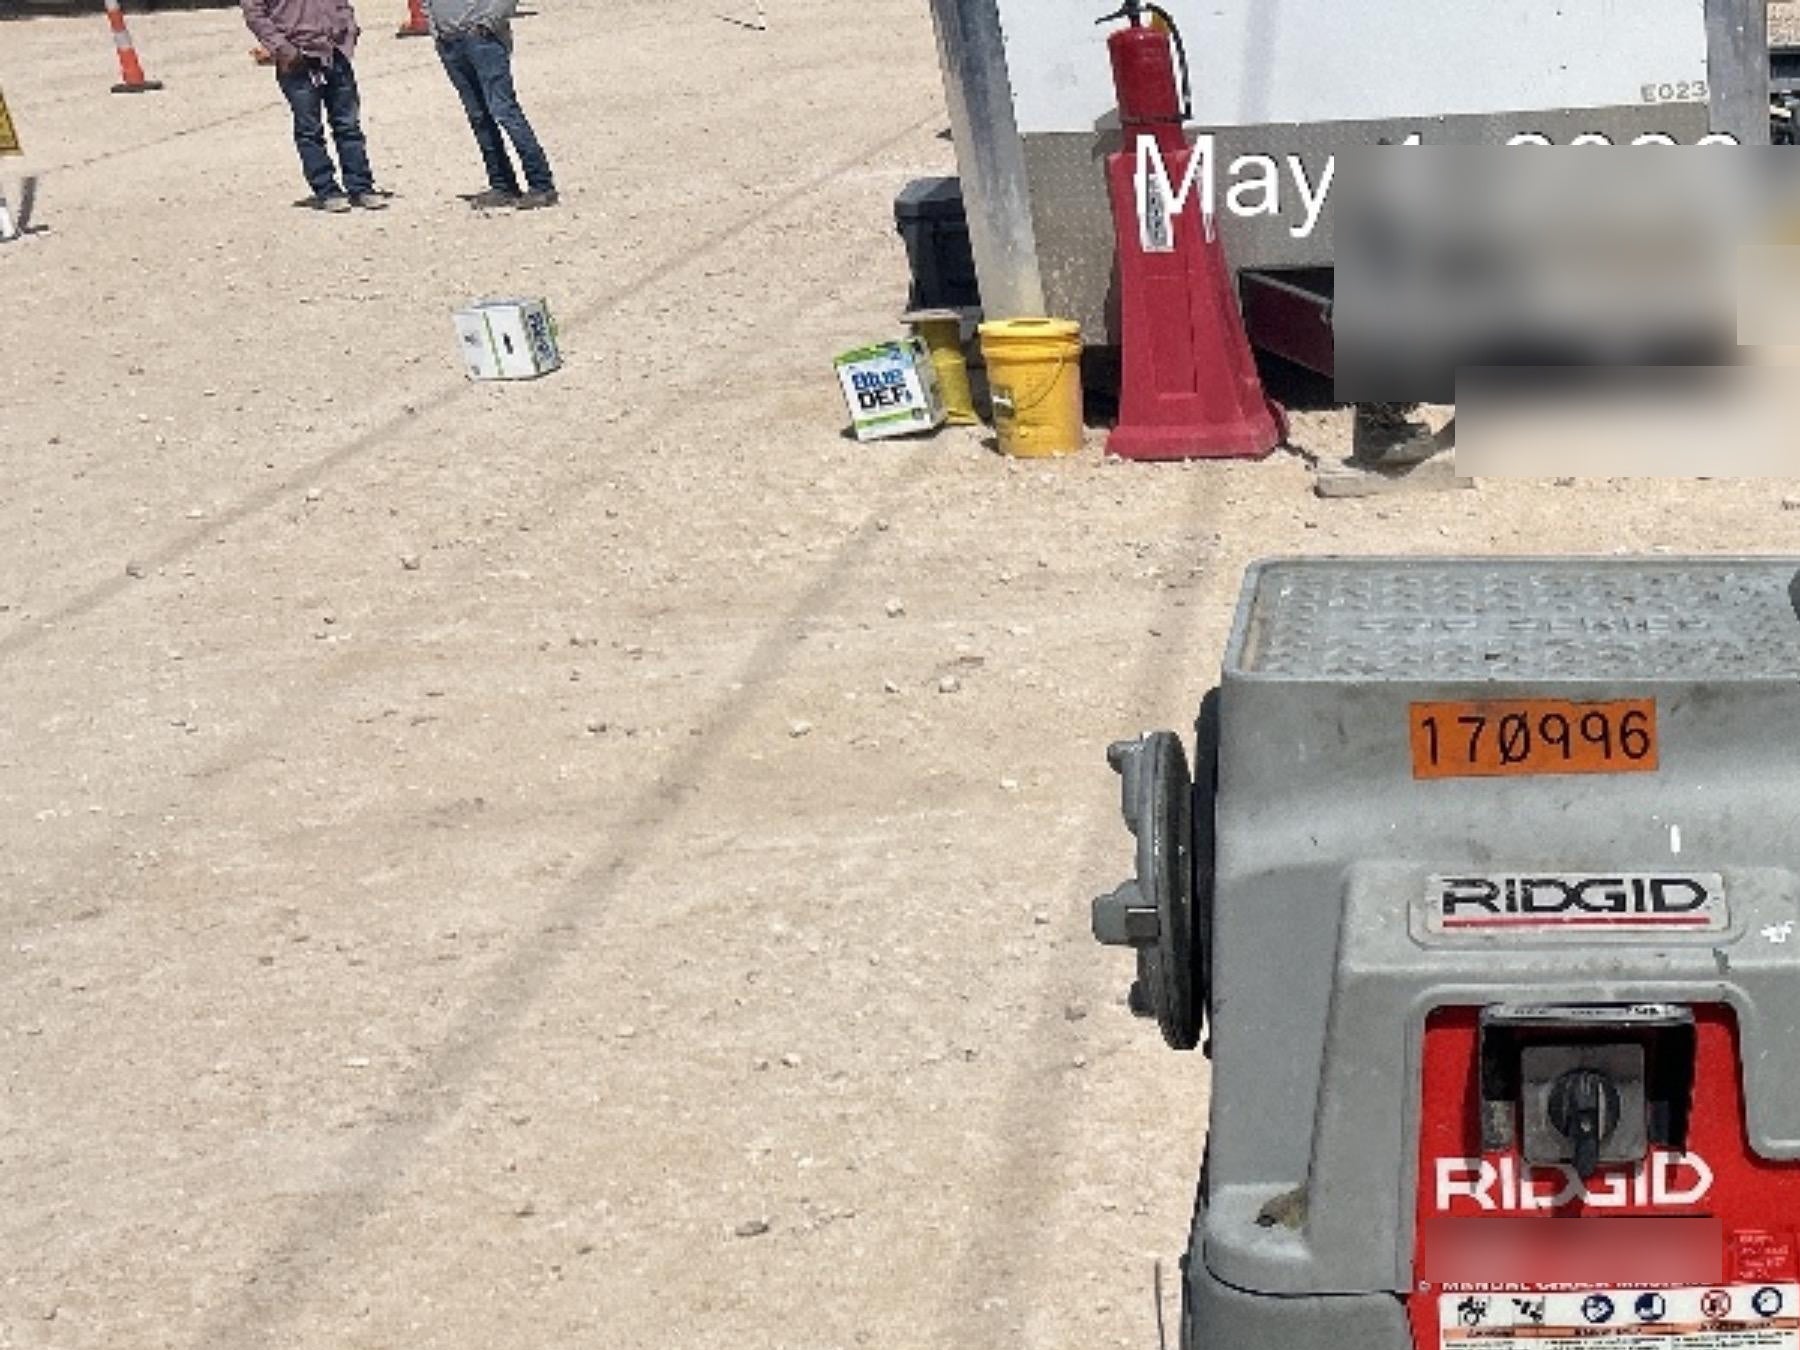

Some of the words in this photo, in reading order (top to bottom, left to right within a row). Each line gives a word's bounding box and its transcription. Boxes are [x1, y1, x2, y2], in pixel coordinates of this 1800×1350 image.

[857, 383, 907, 408] DEF
[1421, 710, 1650, 765] 170996
[1442, 878, 1708, 914] RIDGID
[1435, 1150, 1714, 1211] RIDGID
